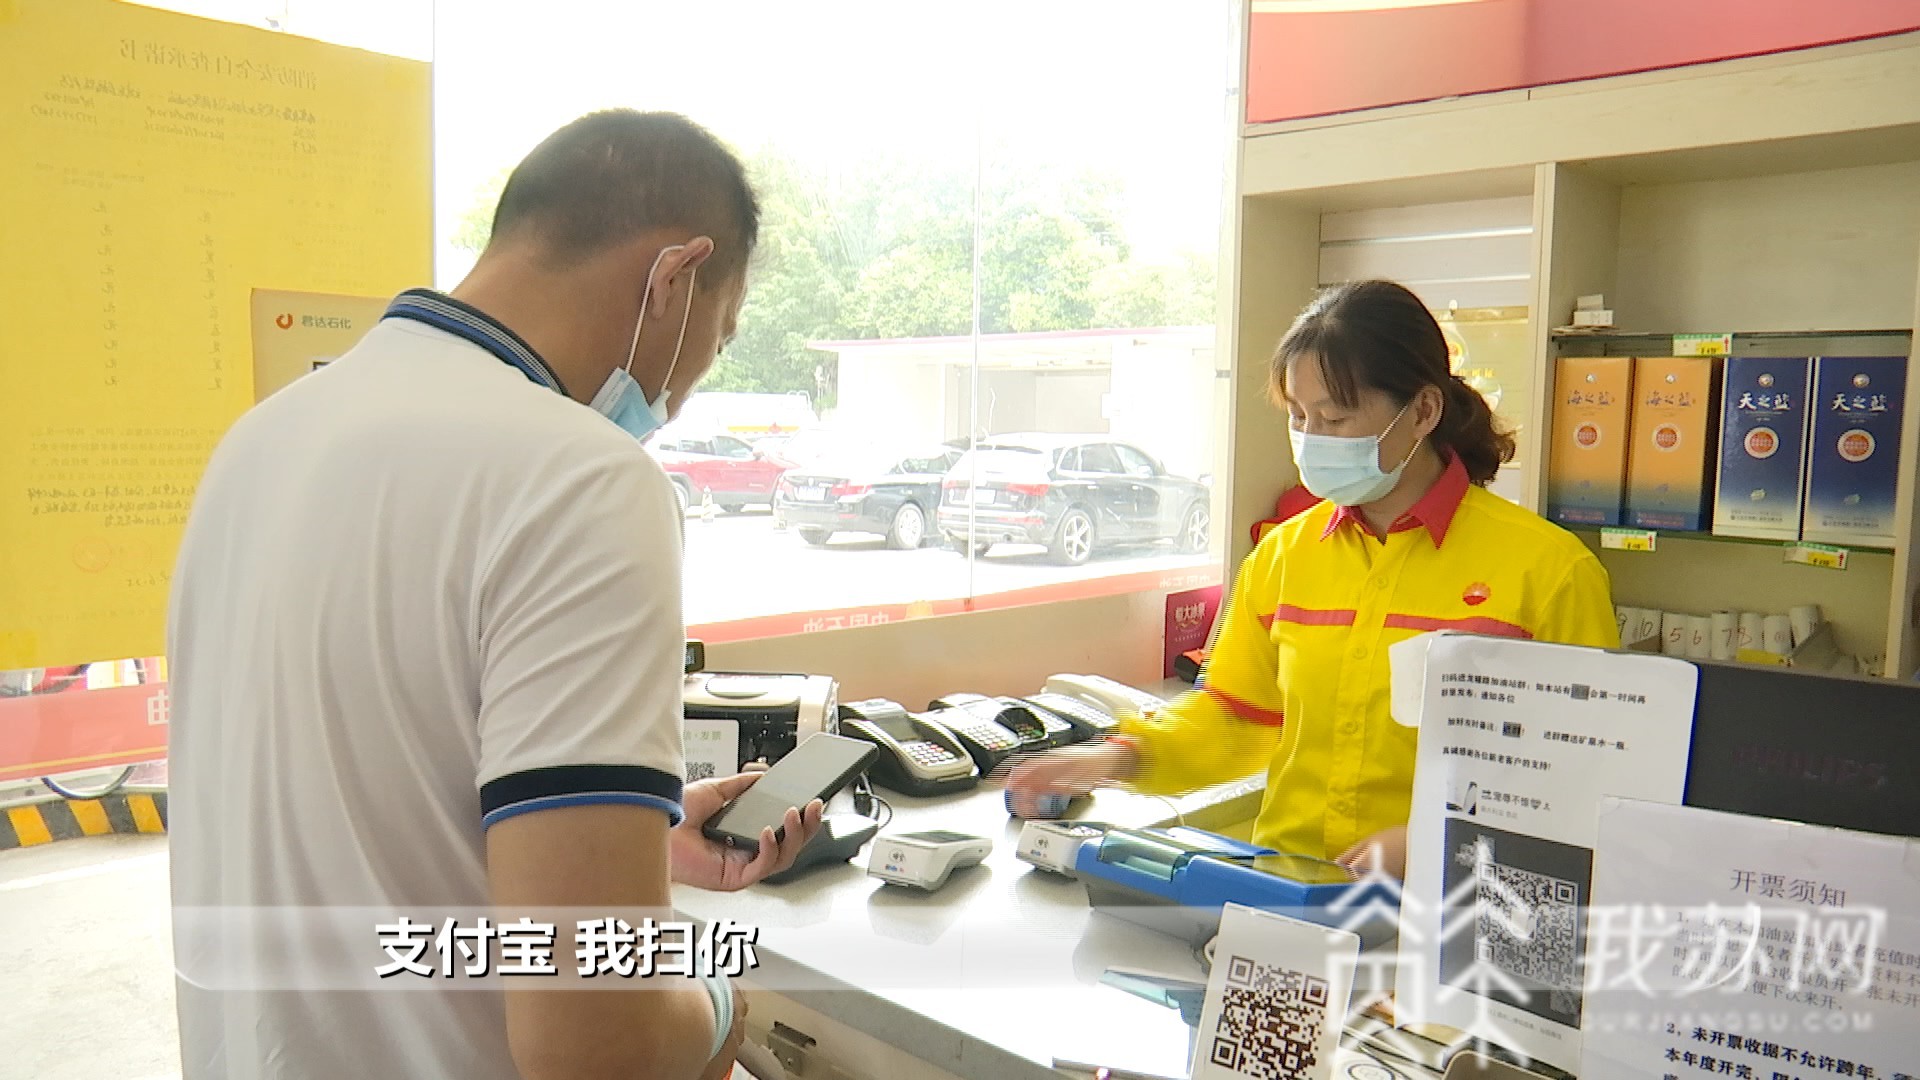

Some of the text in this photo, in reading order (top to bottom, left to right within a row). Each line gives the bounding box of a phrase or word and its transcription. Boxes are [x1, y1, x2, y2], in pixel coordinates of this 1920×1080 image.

[1669, 627, 1682, 643] 5
[1692, 630, 1703, 646] 6
[1721, 628, 1733, 648] 7
[1730, 869, 1847, 909] 开票须知
